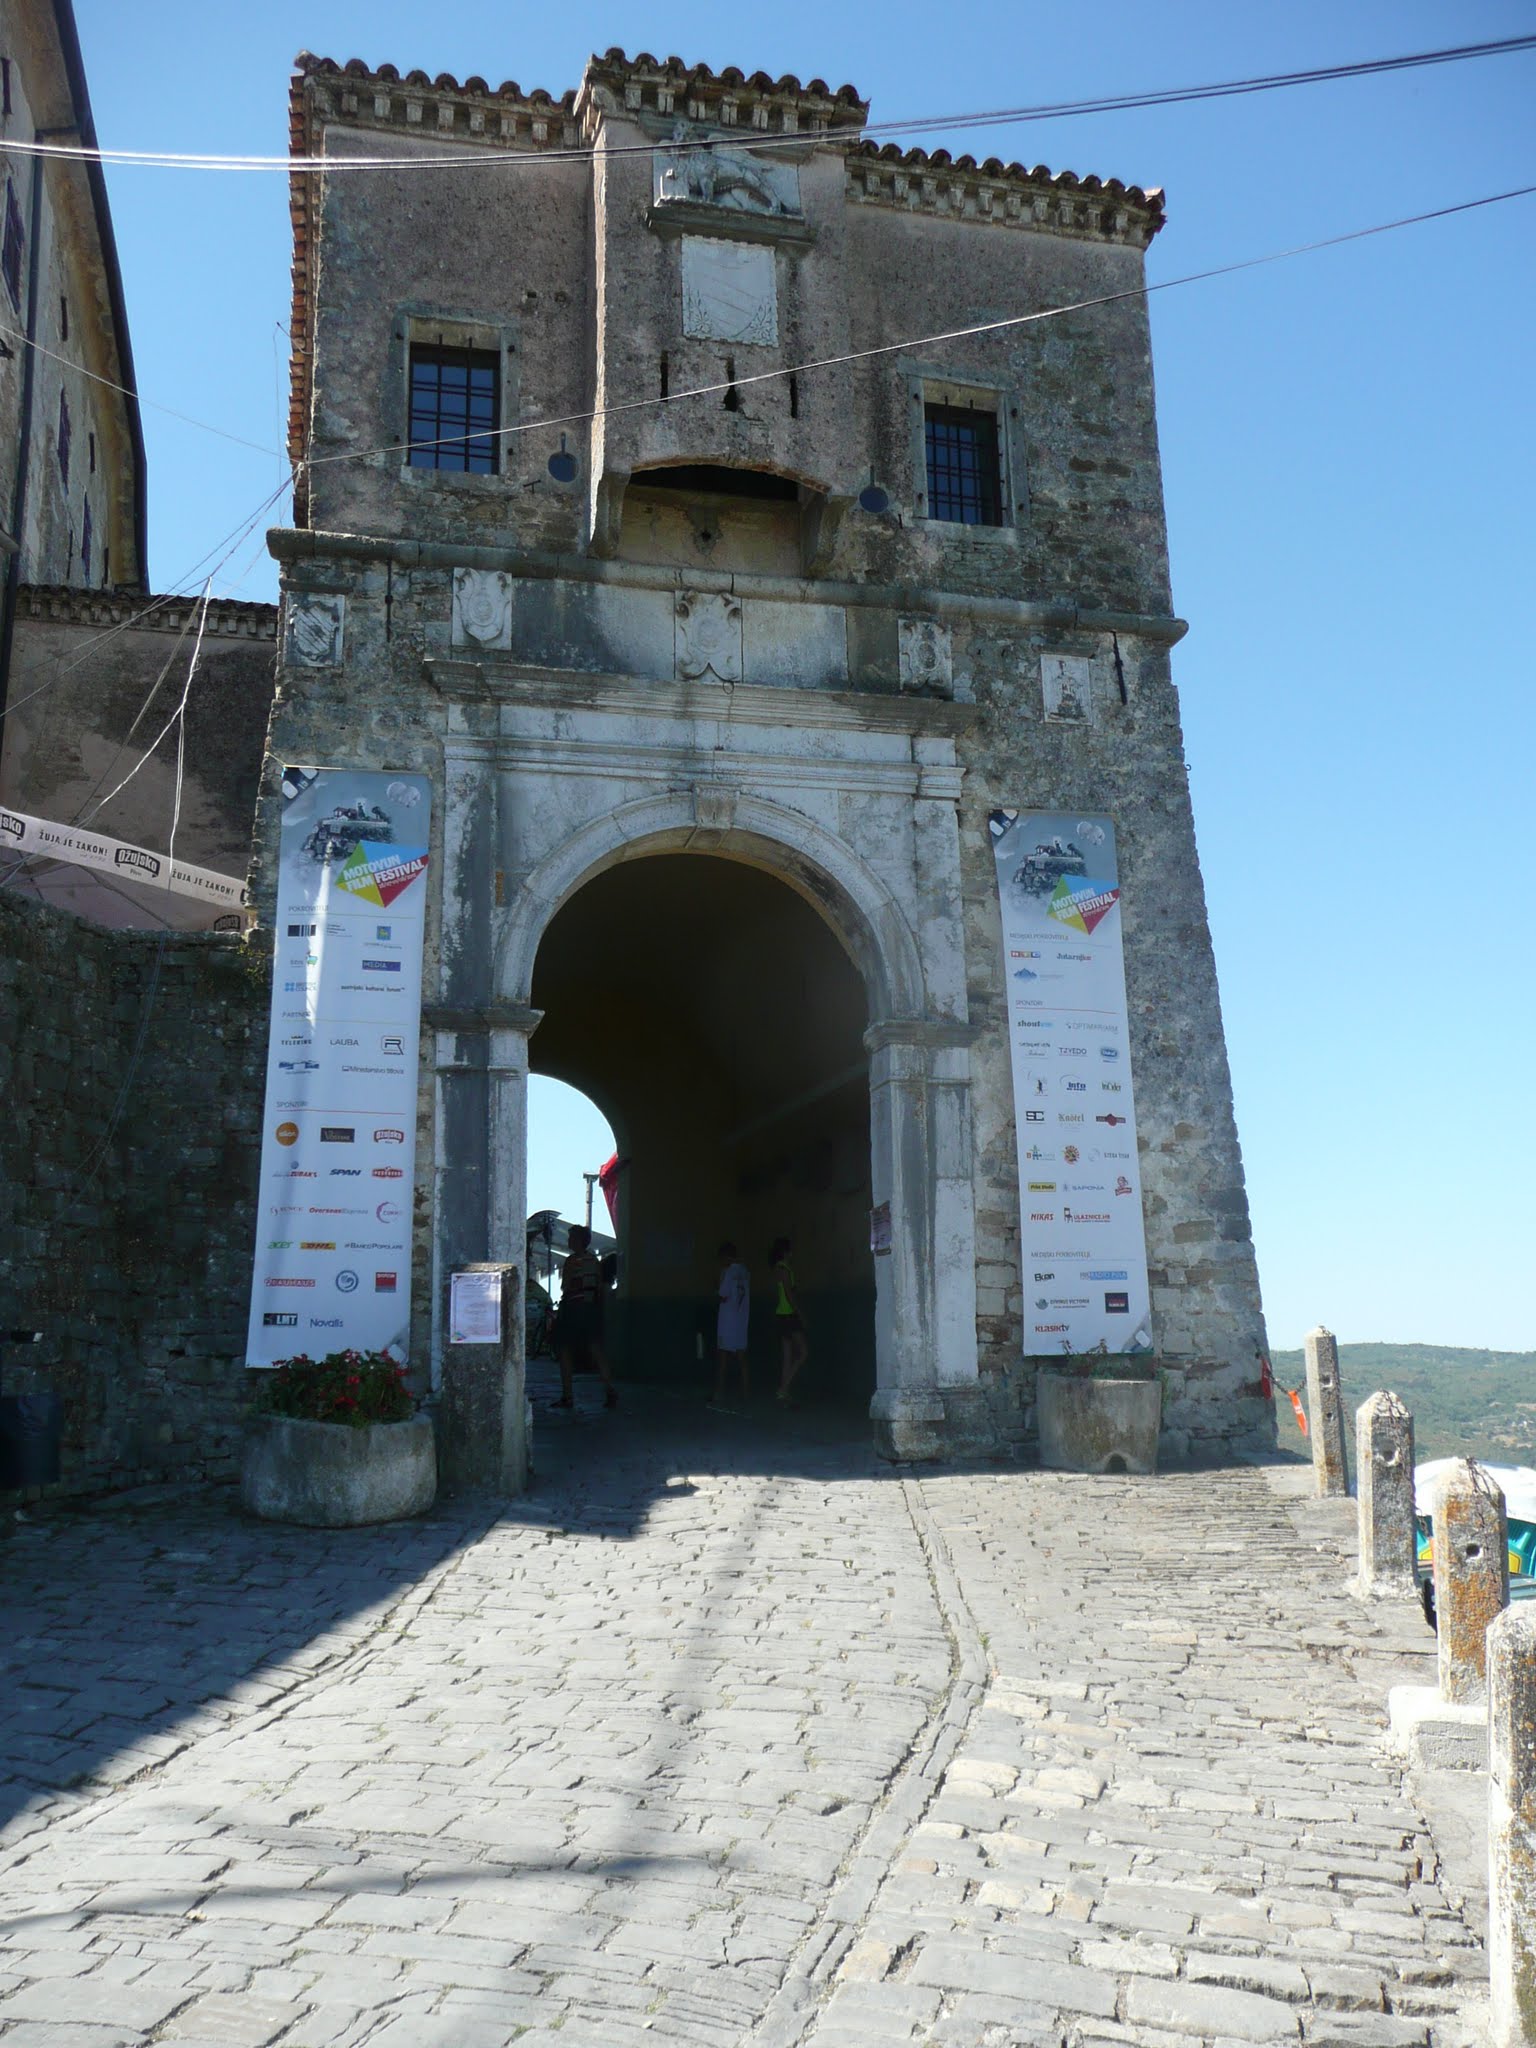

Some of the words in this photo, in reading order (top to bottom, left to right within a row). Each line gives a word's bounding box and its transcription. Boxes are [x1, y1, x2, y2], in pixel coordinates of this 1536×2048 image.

[63, 839, 73, 847] JE
[76, 841, 108, 856] ZAKON!
[343, 854, 400, 880] MOTOVUN
[374, 859, 425, 884] FESTIVAL
[171, 868, 191, 883] ŽUJA
[194, 878, 202, 886] JE
[205, 881, 234, 896] ZAKON!
[345, 875, 374, 890] FILM
[1052, 888, 1096, 911] MOTOVUN
[1078, 892, 1116, 912] FESTIVAL
[1056, 905, 1079, 919] FILM
[329, 1168, 361, 1176] SPAN
[1030, 1213, 1054, 1221] NIKAS
[309, 1318, 344, 1328] Novalis
